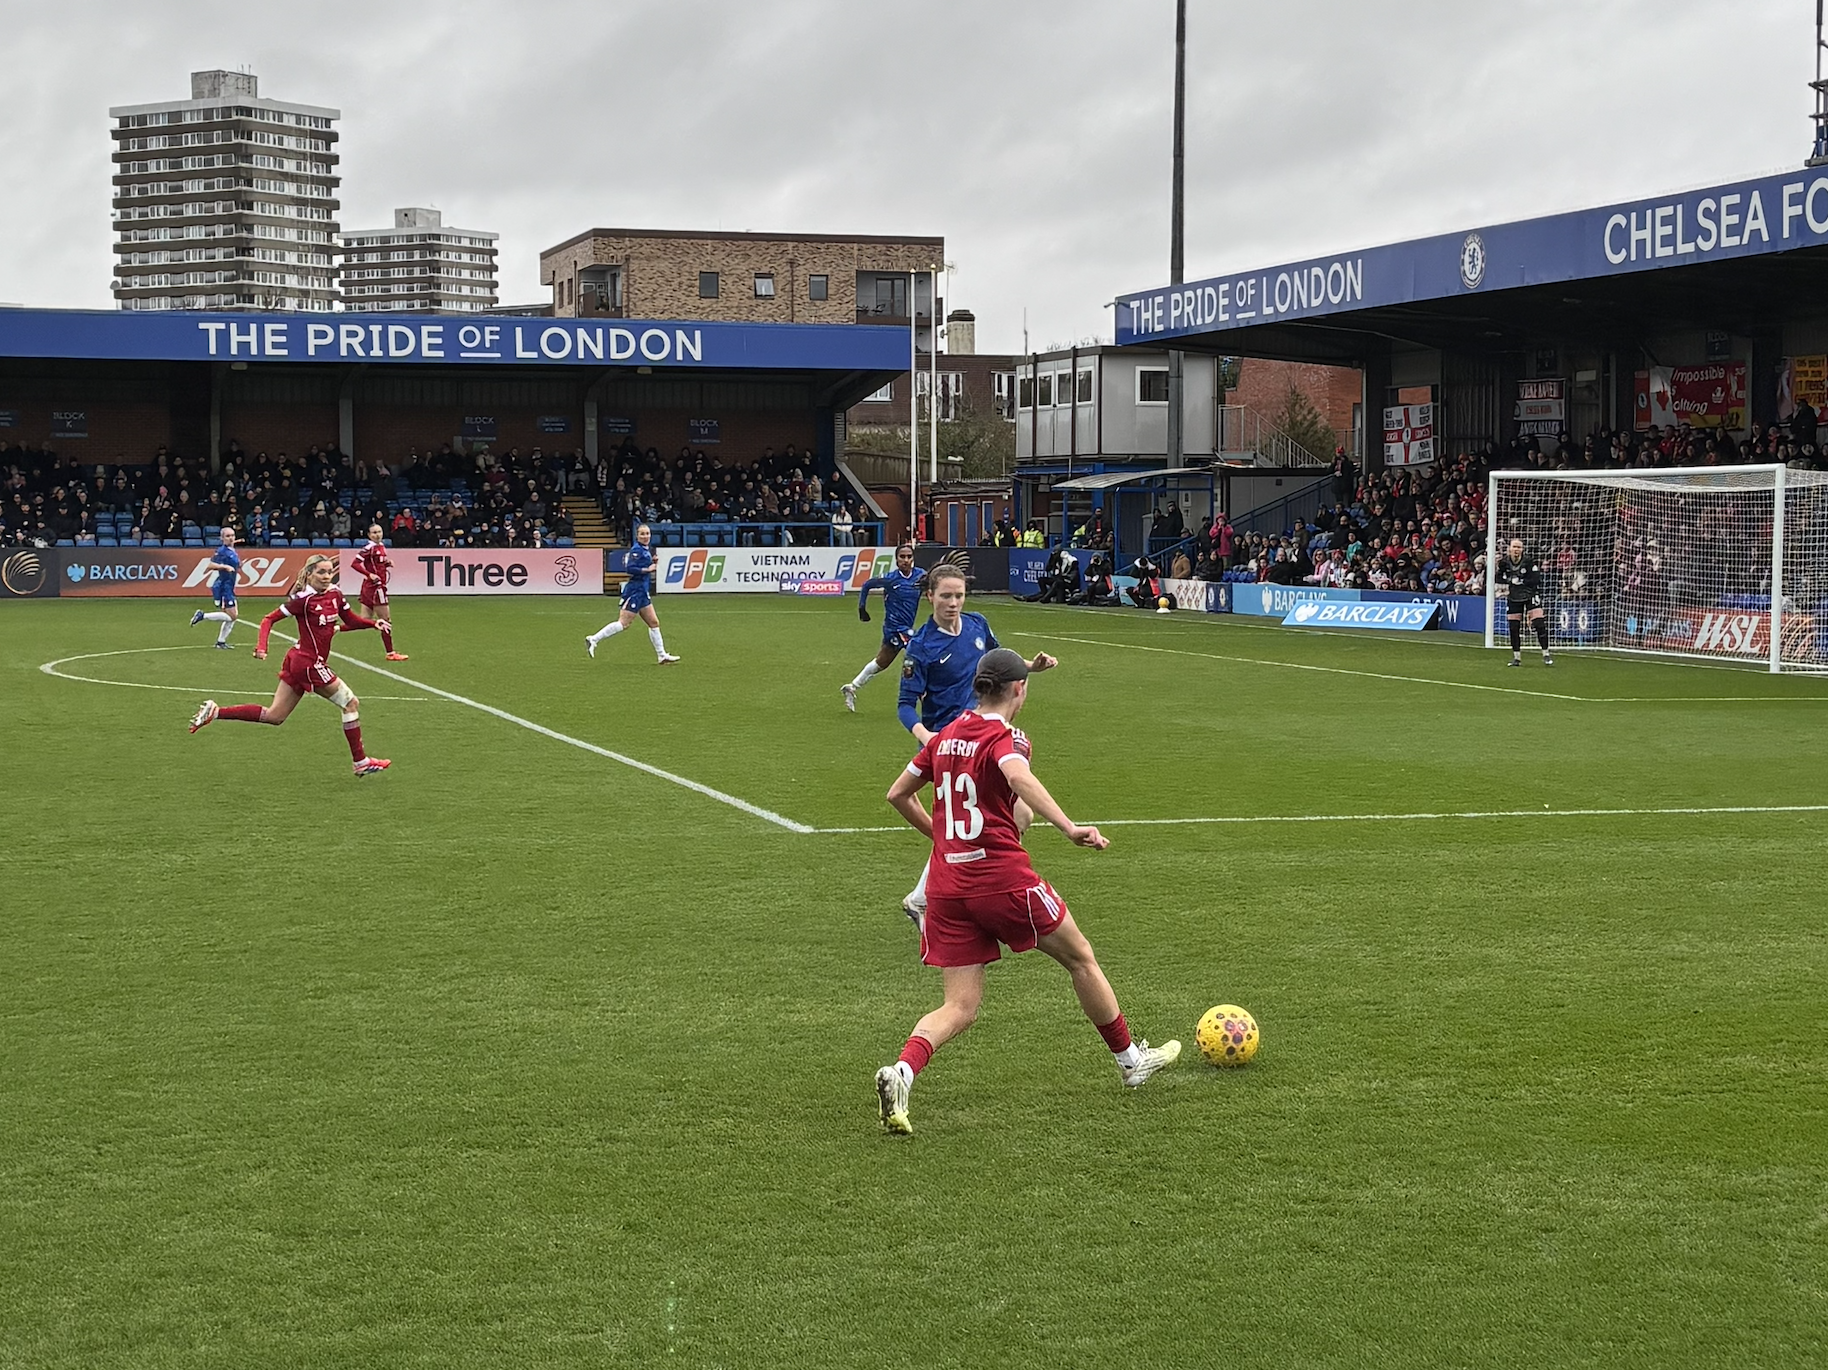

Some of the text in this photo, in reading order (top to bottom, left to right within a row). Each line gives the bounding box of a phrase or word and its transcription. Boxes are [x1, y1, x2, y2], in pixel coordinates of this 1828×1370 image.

[1604, 177, 1828, 264] CHELSEA FC
[1130, 259, 1362, 336] THE PRIDE OF LONDON
[198, 322, 702, 361] THE PRIDE OF LONDON
[89, 564, 178, 581] BARCLAYS
[418, 555, 529, 587] Three
[751, 555, 810, 566] VIETNAM
[736, 571, 826, 583] TECHNOLOGY
[781, 581, 841, 593] sky sports
[1317, 605, 1429, 625] BARCLAYS
[1694, 613, 1763, 653] WSL
[936, 771, 984, 841] 13
